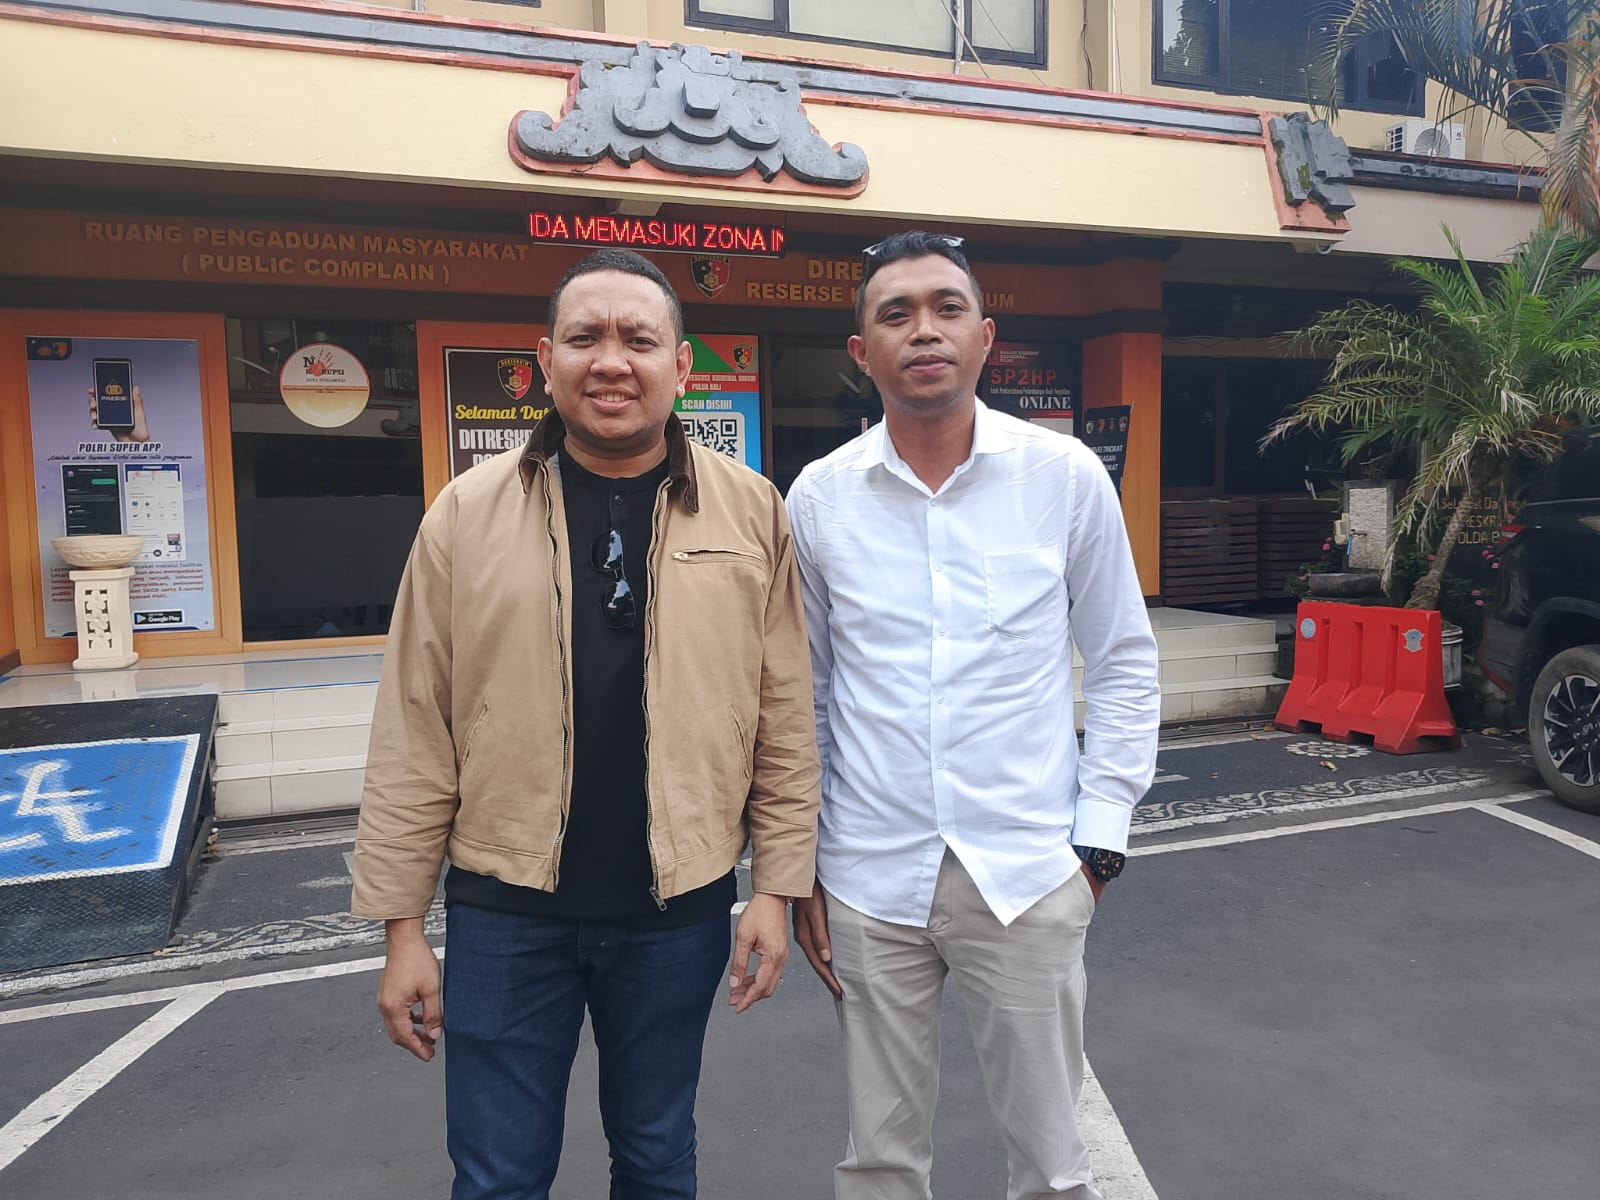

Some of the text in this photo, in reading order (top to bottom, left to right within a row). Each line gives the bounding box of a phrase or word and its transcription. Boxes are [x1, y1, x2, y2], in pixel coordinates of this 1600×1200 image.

[528, 212, 569, 239] DA
[575, 214, 697, 247] MEMASUKI
[703, 224, 767, 252] ZONA
[85, 221, 529, 262] RUANG PENGADUAN MASYARAKAT
[199, 253, 296, 274] PUBLIC
[304, 258, 435, 281] COMPLAIN
[808, 259, 863, 281] DIRE
[746, 281, 844, 302] RESERSE
[982, 290, 1015, 309] UM
[303, 356, 316, 368] N
[305, 368, 345, 376] KRUPSI
[991, 368, 1057, 386] SP2HP
[681, 399, 733, 410] SCAN DISINI
[1019, 396, 1071, 409] ONLINE
[455, 404, 551, 420] Selamat Dat
[459, 428, 534, 450] DITRESK
[78, 443, 162, 453] POLRI SUPER APP
[1457, 531, 1501, 544] OLDA B
